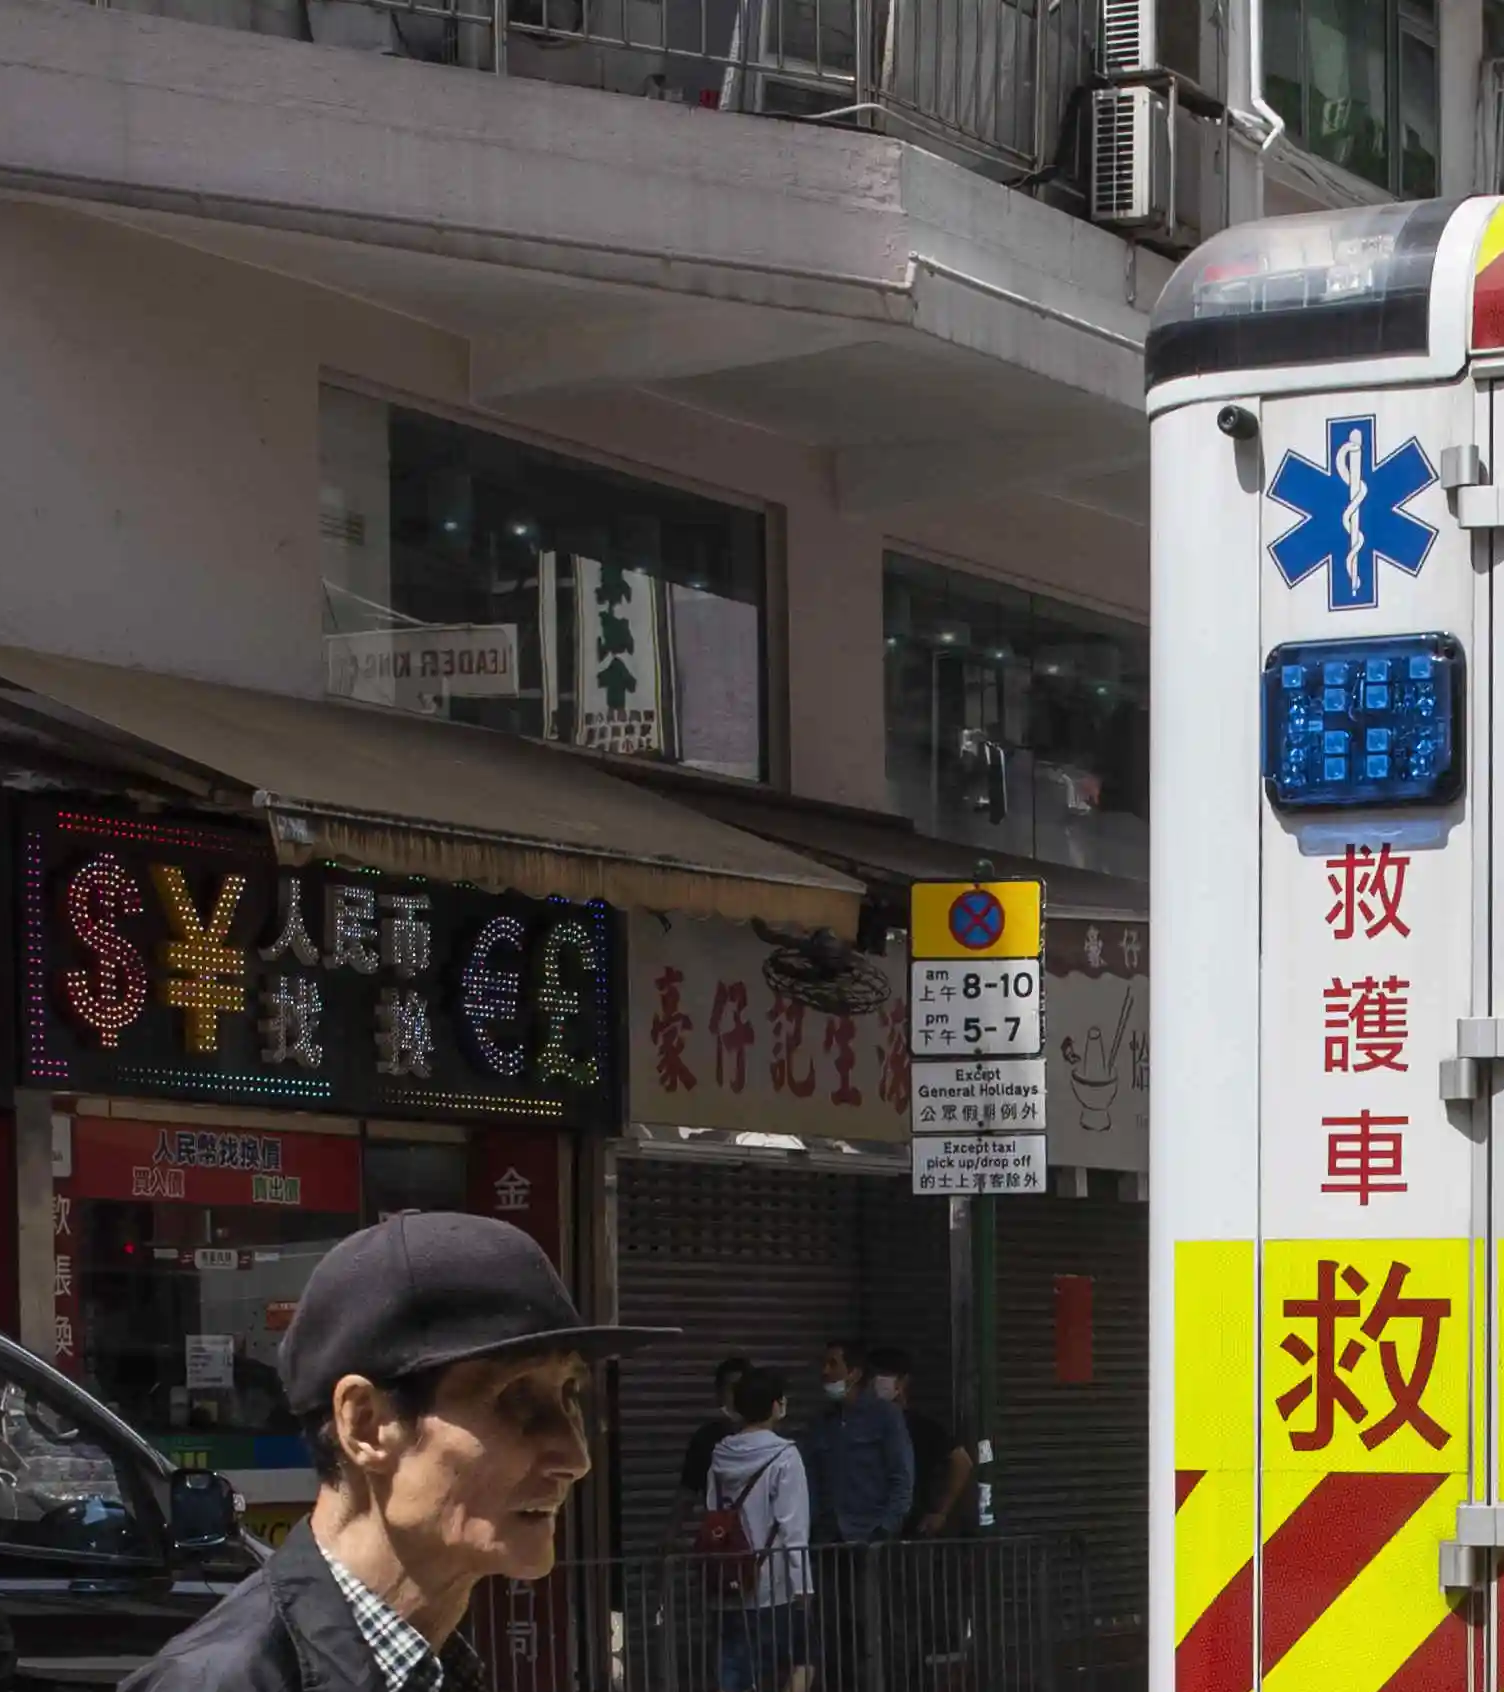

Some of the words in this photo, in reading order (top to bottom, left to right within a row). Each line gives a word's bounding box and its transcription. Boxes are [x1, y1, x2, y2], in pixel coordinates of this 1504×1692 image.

[926, 970, 949, 981] am
[962, 972, 1033, 999] 8-10
[919, 985, 957, 1003] 上午
[926, 1014, 949, 1027] pm
[1321, 842, 1411, 1207] 救護車
[918, 1029, 957, 1047] 下午
[918, 1085, 975, 1098] General
[979, 1083, 1038, 1098] Holidays
[943, 1141, 989, 1155] Except
[992, 1140, 1016, 1154] taxi
[927, 1157, 955, 1171] pick
[958, 1156, 1009, 1171] up/drop
[1013, 1154, 1031, 1167] off
[1274, 1259, 1452, 1453] 救
